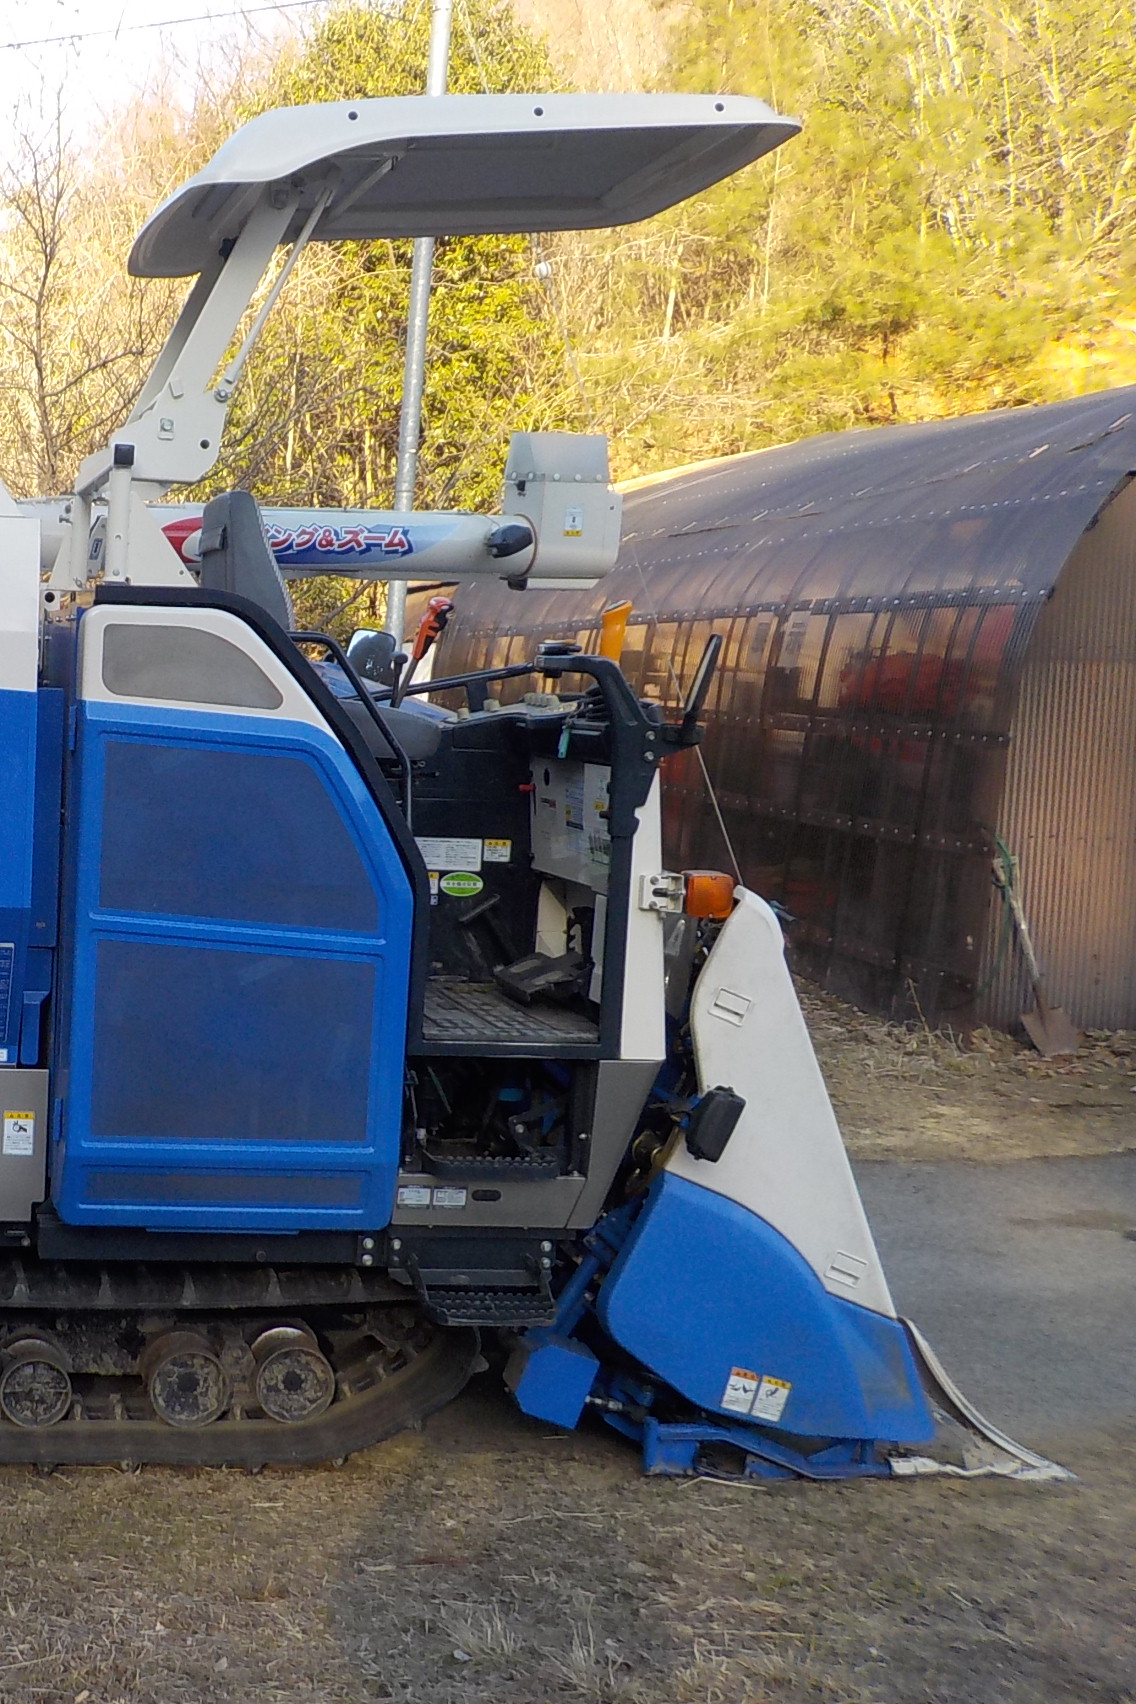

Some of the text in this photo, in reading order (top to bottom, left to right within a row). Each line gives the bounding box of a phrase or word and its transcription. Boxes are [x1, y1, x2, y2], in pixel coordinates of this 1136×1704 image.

[264, 524, 411, 554] ング&ズーム
